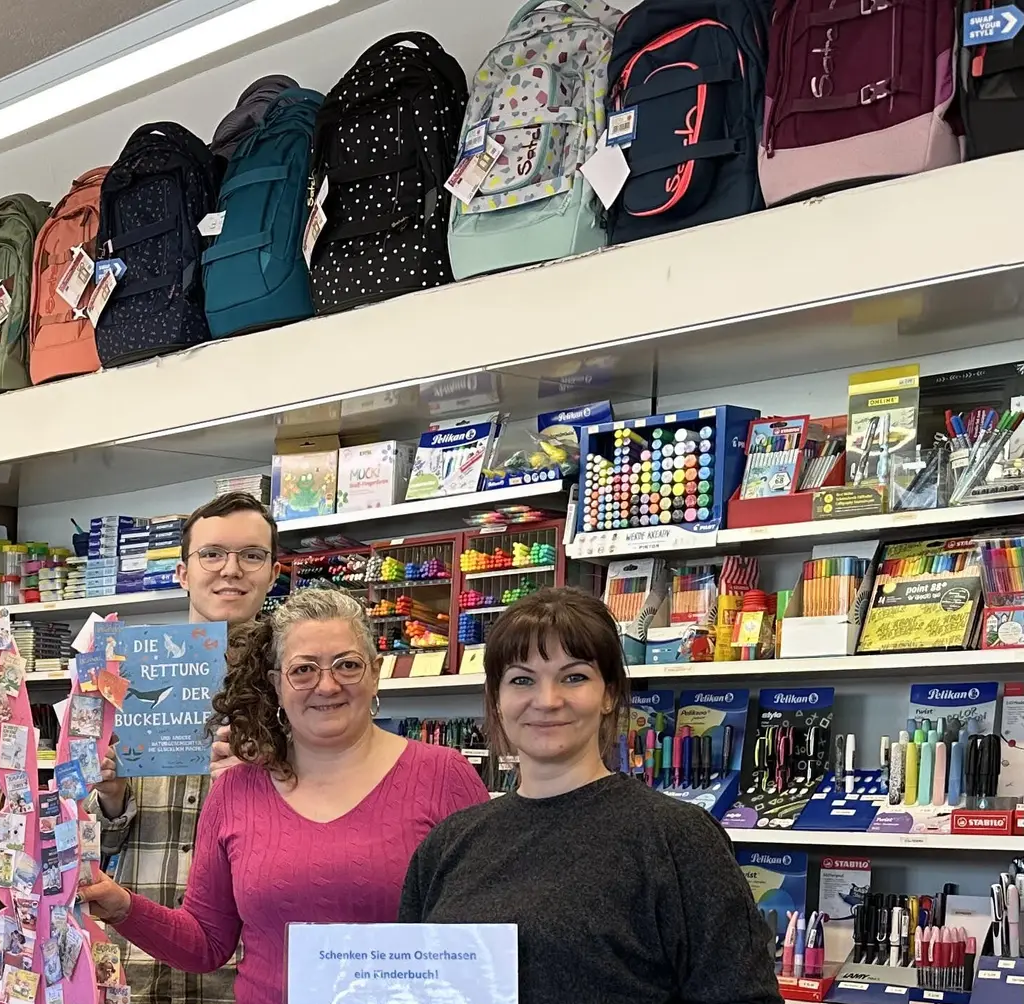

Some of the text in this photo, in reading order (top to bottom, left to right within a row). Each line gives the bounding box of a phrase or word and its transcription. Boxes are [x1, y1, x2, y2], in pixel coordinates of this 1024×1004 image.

[969, 15, 994, 25] SWAP
[979, 20, 1001, 29] YOUR
[969, 28, 994, 38] STYLE
[431, 432, 465, 446] Pelikan
[906, 584, 929, 594] point
[133, 639, 158, 653] DIE
[140, 662, 210, 681] RETTUNG
[182, 687, 211, 700] DER
[694, 692, 725, 703] Pelikan
[773, 693, 808, 704] Pelikan
[927, 688, 968, 700] Pelikan
[632, 695, 652, 704] likan
[968, 818, 1006, 827] STABILO
[750, 852, 782, 865] Pelikan
[833, 859, 870, 869] STABILO
[319, 950, 368, 960] Schenken
[370, 950, 386, 960] Sie
[414, 950, 477, 960] Osterhasen
[354, 970, 370, 979] ein
